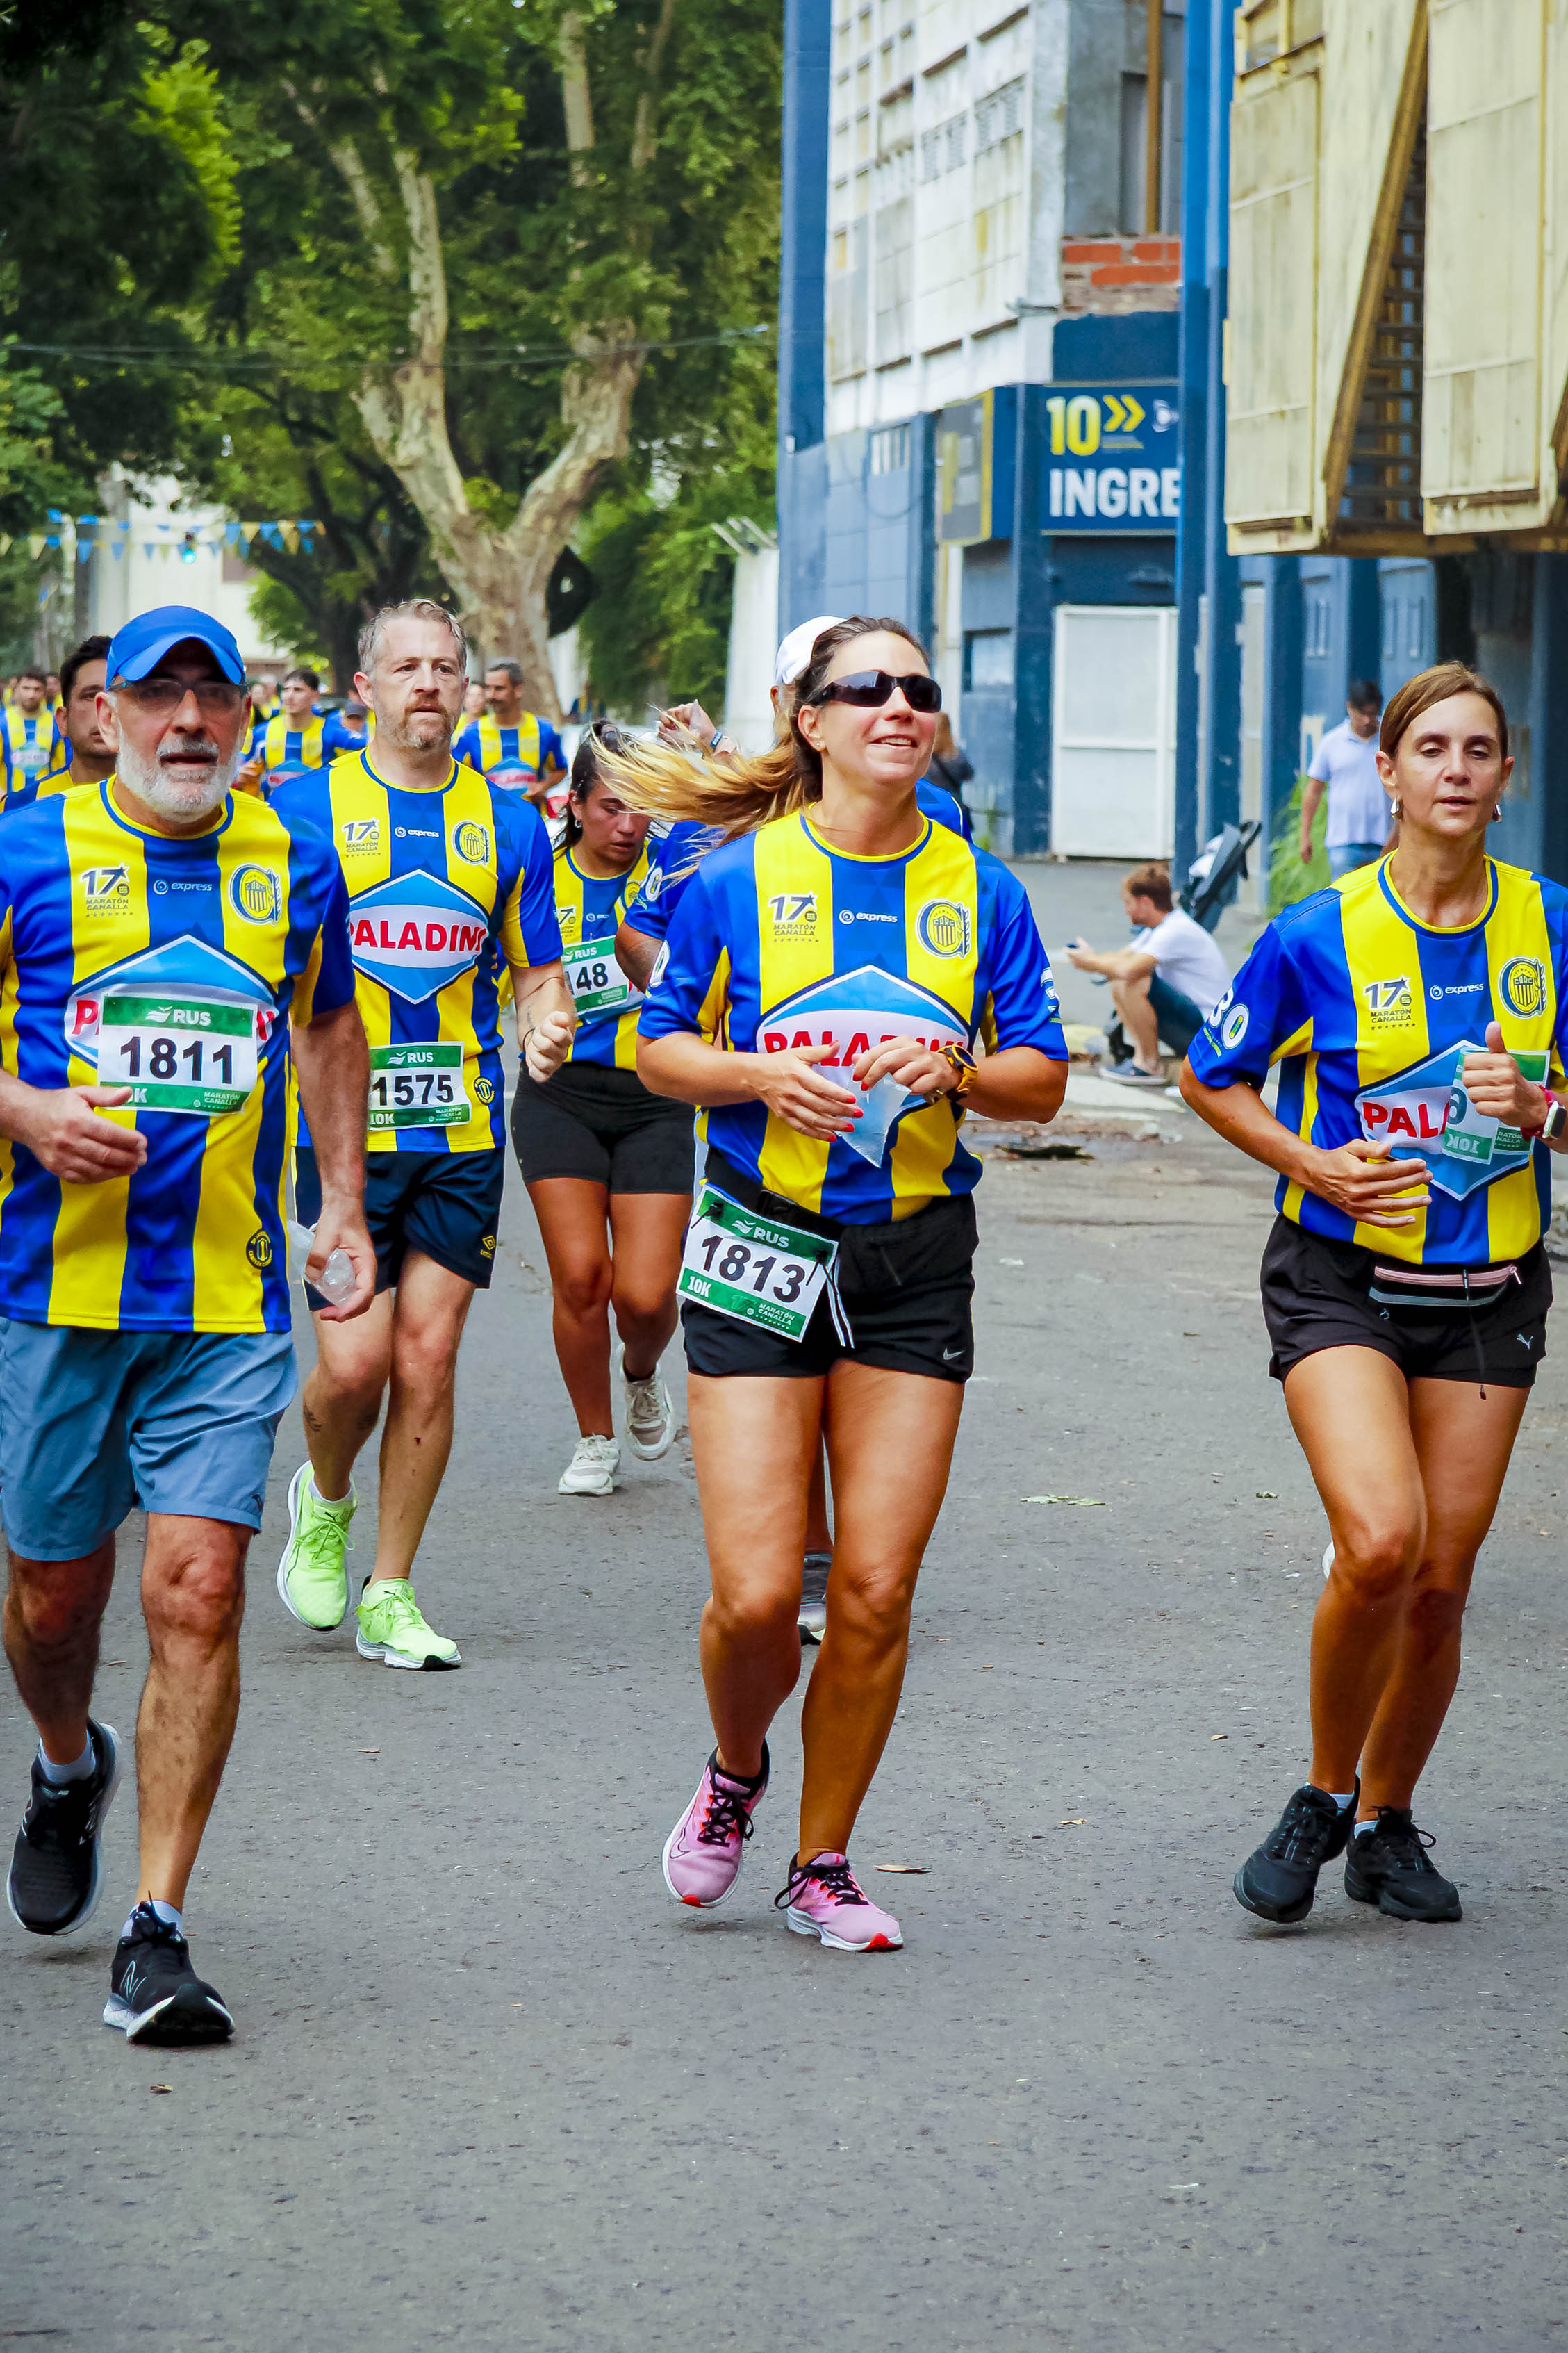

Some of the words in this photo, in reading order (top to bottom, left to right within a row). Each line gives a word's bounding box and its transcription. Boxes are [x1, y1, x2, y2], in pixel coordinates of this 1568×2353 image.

[1046, 395, 1101, 456] 10
[343, 819, 379, 842] 17
[408, 829, 439, 837] express
[81, 864, 128, 896] 17
[171, 881, 213, 892] express
[770, 892, 816, 921] 17
[855, 911, 898, 923] express
[575, 946, 597, 959] RUS
[1364, 976, 1409, 1008] 17
[1445, 983, 1484, 995] express
[174, 1009, 211, 1026] RUS
[1370, 1008, 1411, 1017] MARATÓN
[1371, 1015, 1411, 1024] CANALLA
[120, 1036, 232, 1085] 1811
[407, 1051, 434, 1063] RUS
[372, 1074, 454, 1106] 1575
[369, 1113, 395, 1125] 10K
[753, 1226, 790, 1248] RUS
[702, 1235, 805, 1303] 1813
[687, 1276, 712, 1298] 10K
[758, 1309, 791, 1325] CANALLA
[759, 1303, 795, 1320] MARATÓN
